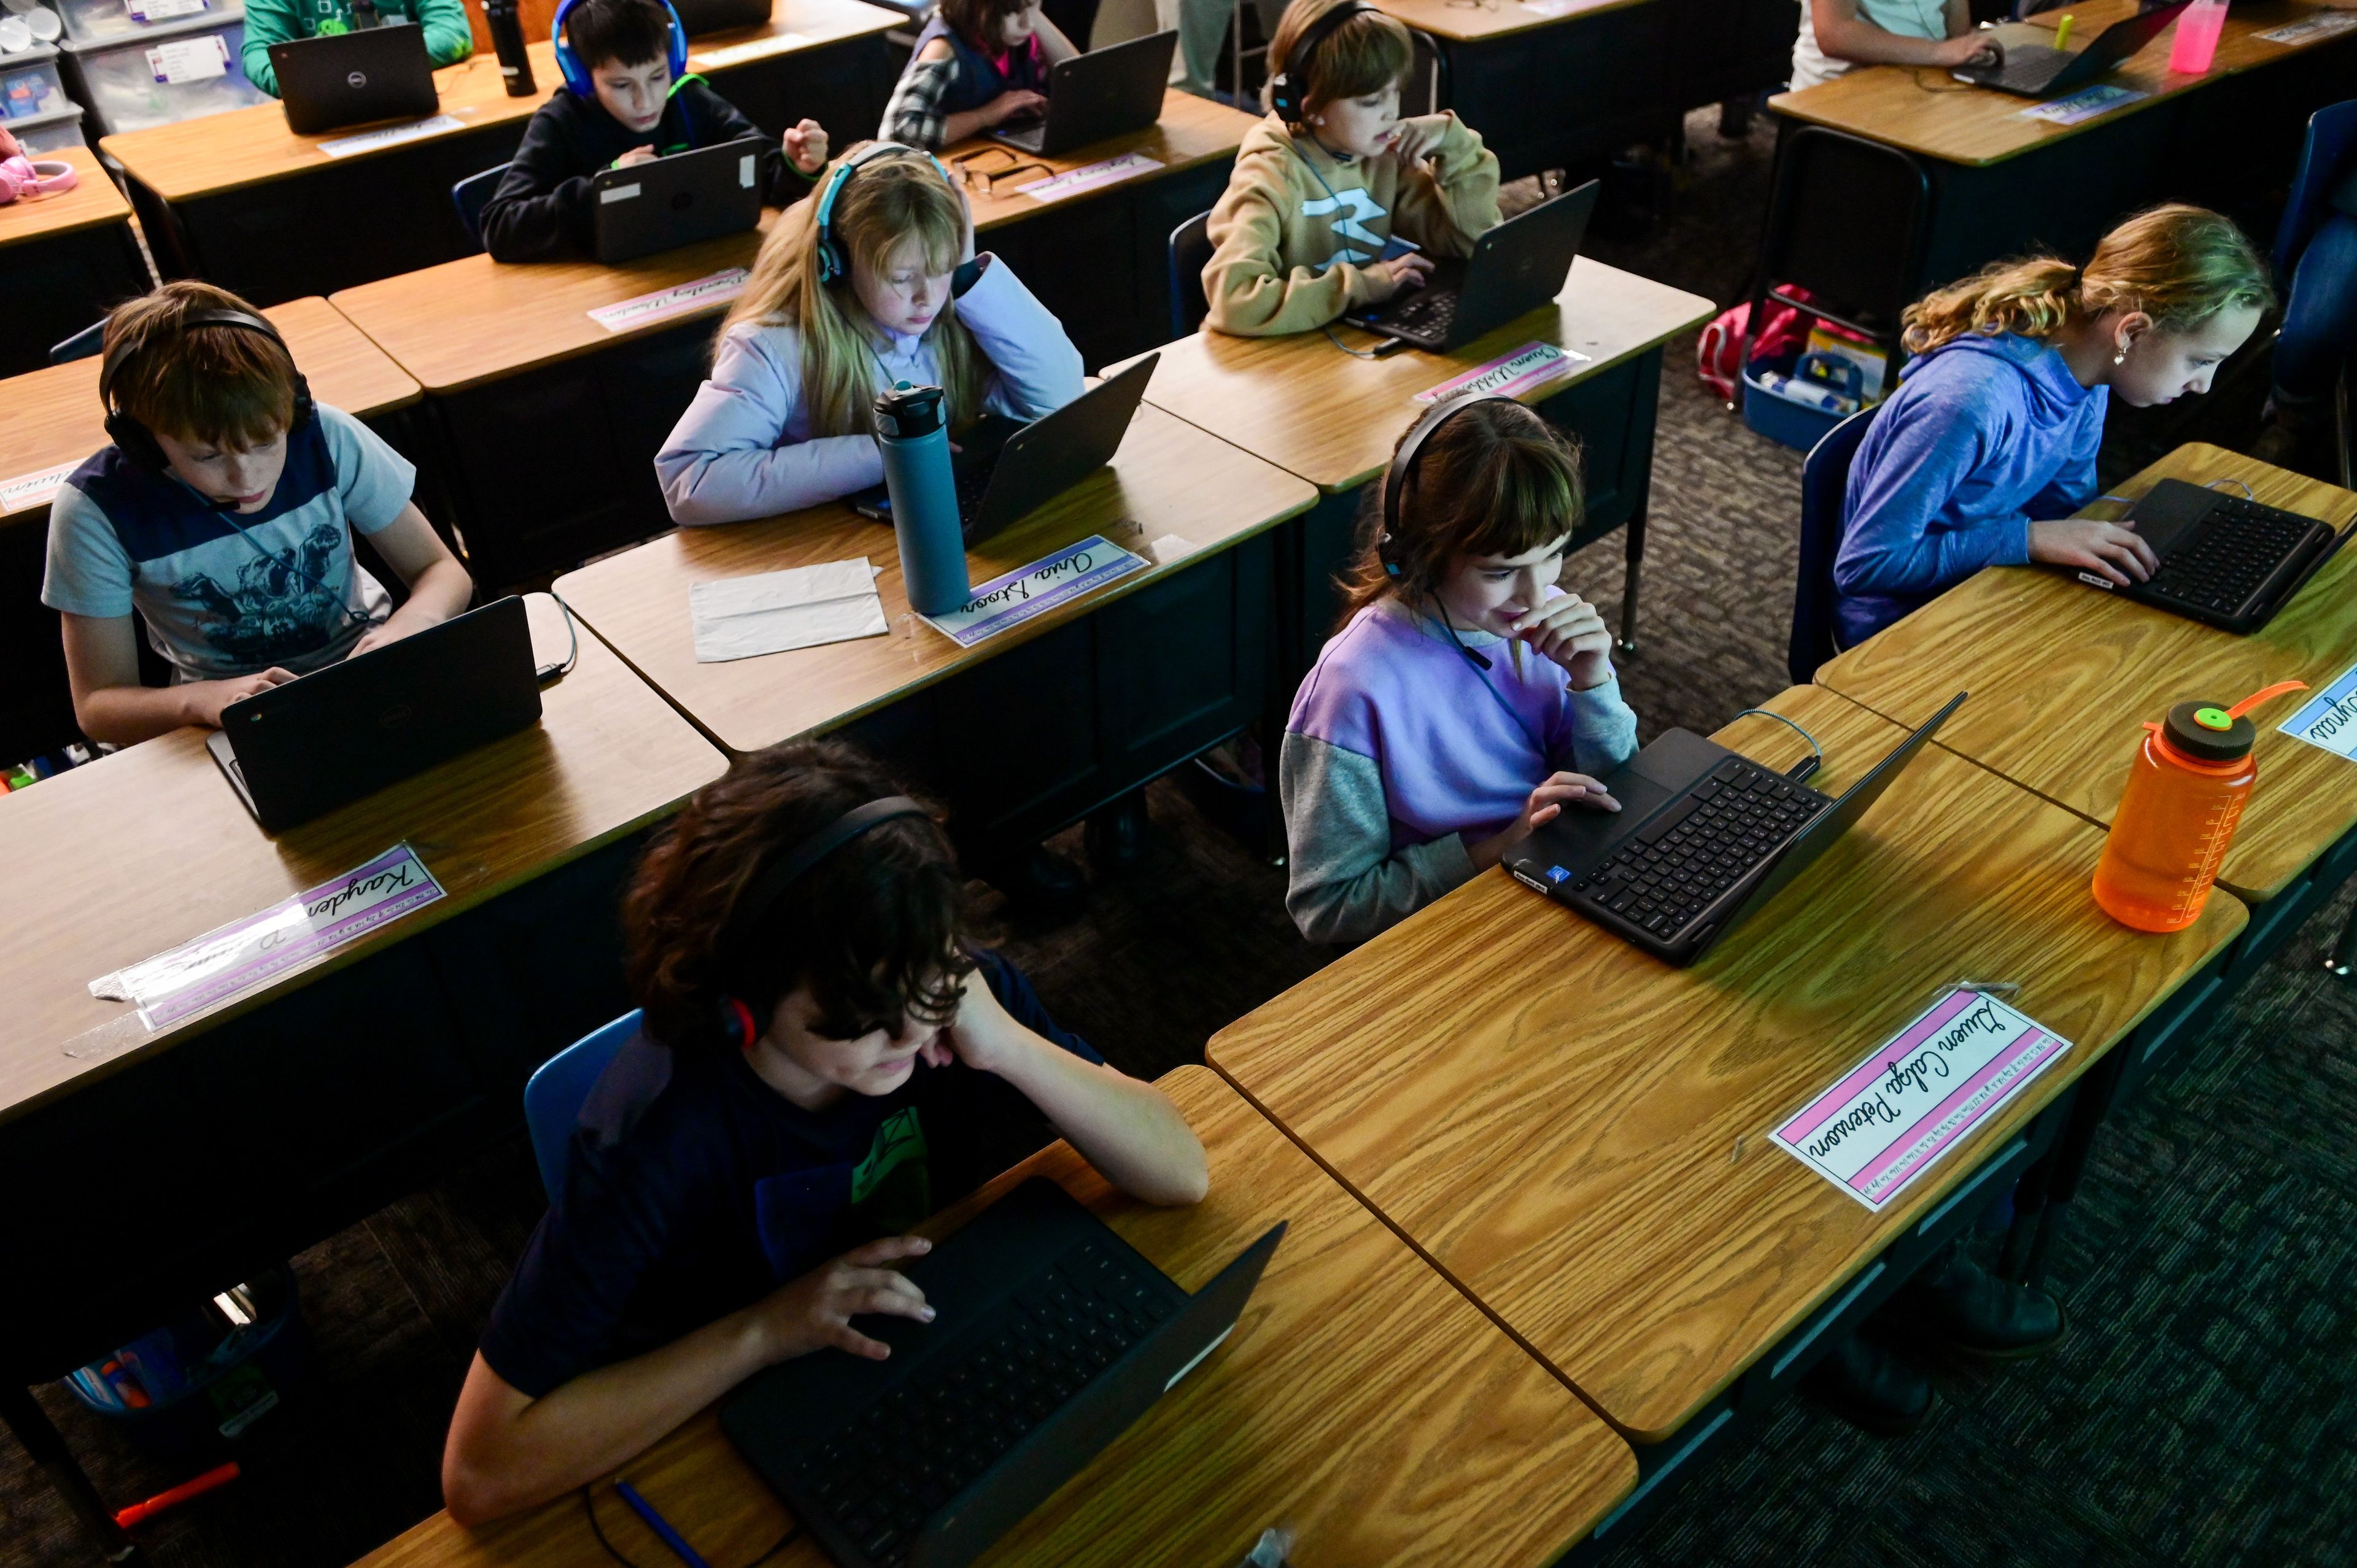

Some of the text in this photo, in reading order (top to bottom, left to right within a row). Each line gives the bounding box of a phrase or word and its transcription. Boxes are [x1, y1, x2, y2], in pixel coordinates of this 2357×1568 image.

[3, 471, 71, 493] dwin
[1034, 552, 1093, 580] Aria
[959, 579, 1030, 613] Stoor
[1809, 1001, 2006, 1157] Gwen Calza Peterson
